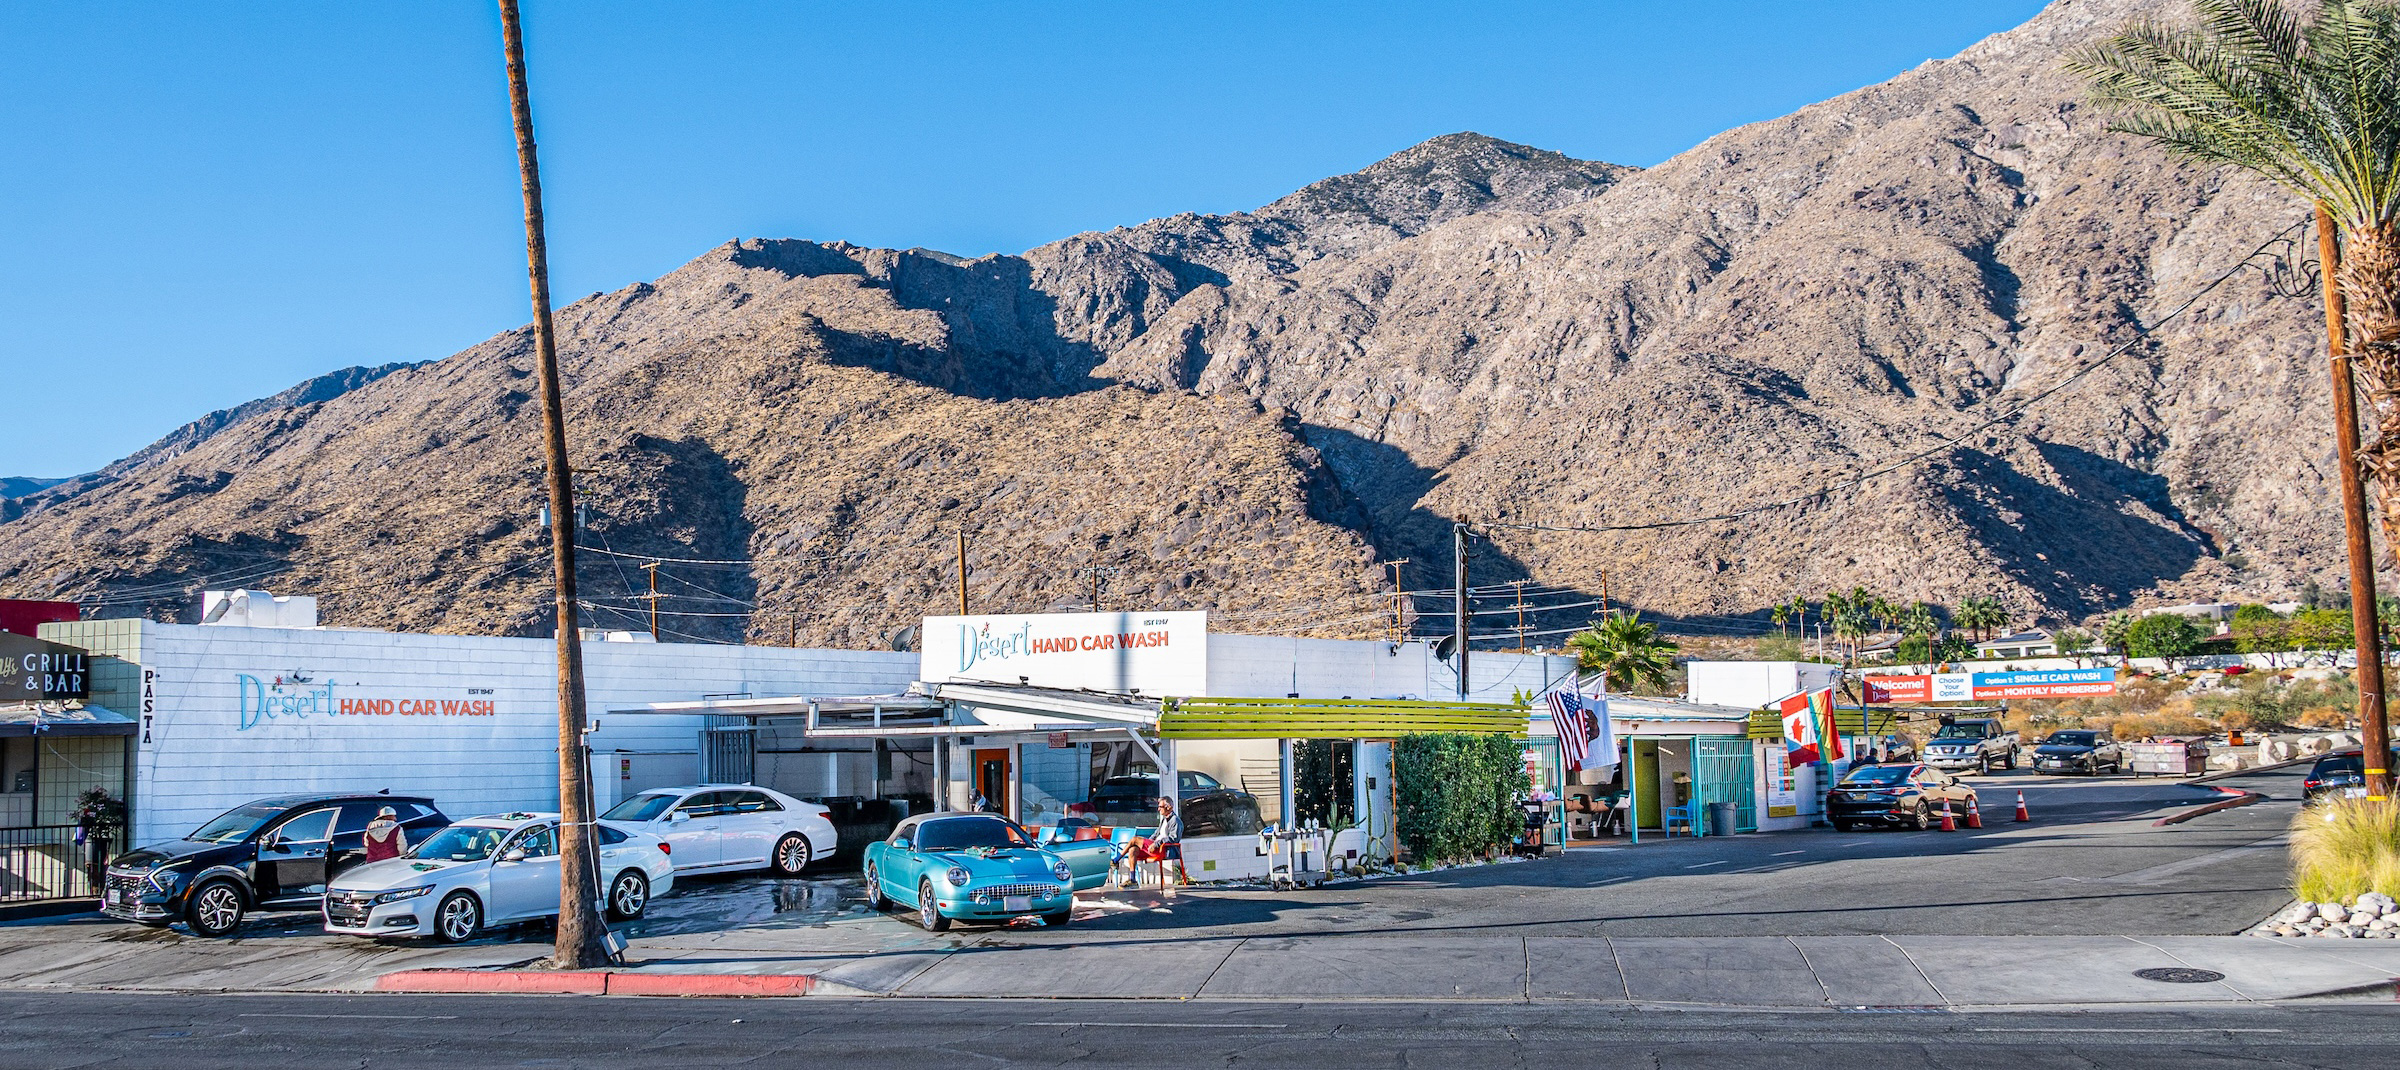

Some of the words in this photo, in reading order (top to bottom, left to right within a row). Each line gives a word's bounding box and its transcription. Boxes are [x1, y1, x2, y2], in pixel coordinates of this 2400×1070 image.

[957, 621, 1031, 673] Desert
[1032, 637, 1077, 654] HAND
[1081, 634, 1115, 651] CAR
[1117, 630, 1169, 649] WASH
[23, 653, 86, 672] GRILL
[25, 675, 39, 690] &
[44, 673, 82, 692] BAR
[1870, 679, 1925, 690] Welcome!
[1985, 677, 2008, 686] Option
[2014, 673, 2049, 683] SINGLE
[2049, 673, 2070, 682] CAR
[2071, 672, 2101, 681] WASH
[1975, 690, 1997, 698] Option
[2004, 686, 2049, 696] MONTHLY
[2050, 684, 2113, 695] MEMBERSHIP
[143, 670, 154, 744] PASTA
[235, 673, 338, 731] Desert
[340, 698, 395, 716] HAND
[399, 699, 437, 716] CAR
[441, 700, 495, 717] WASH
